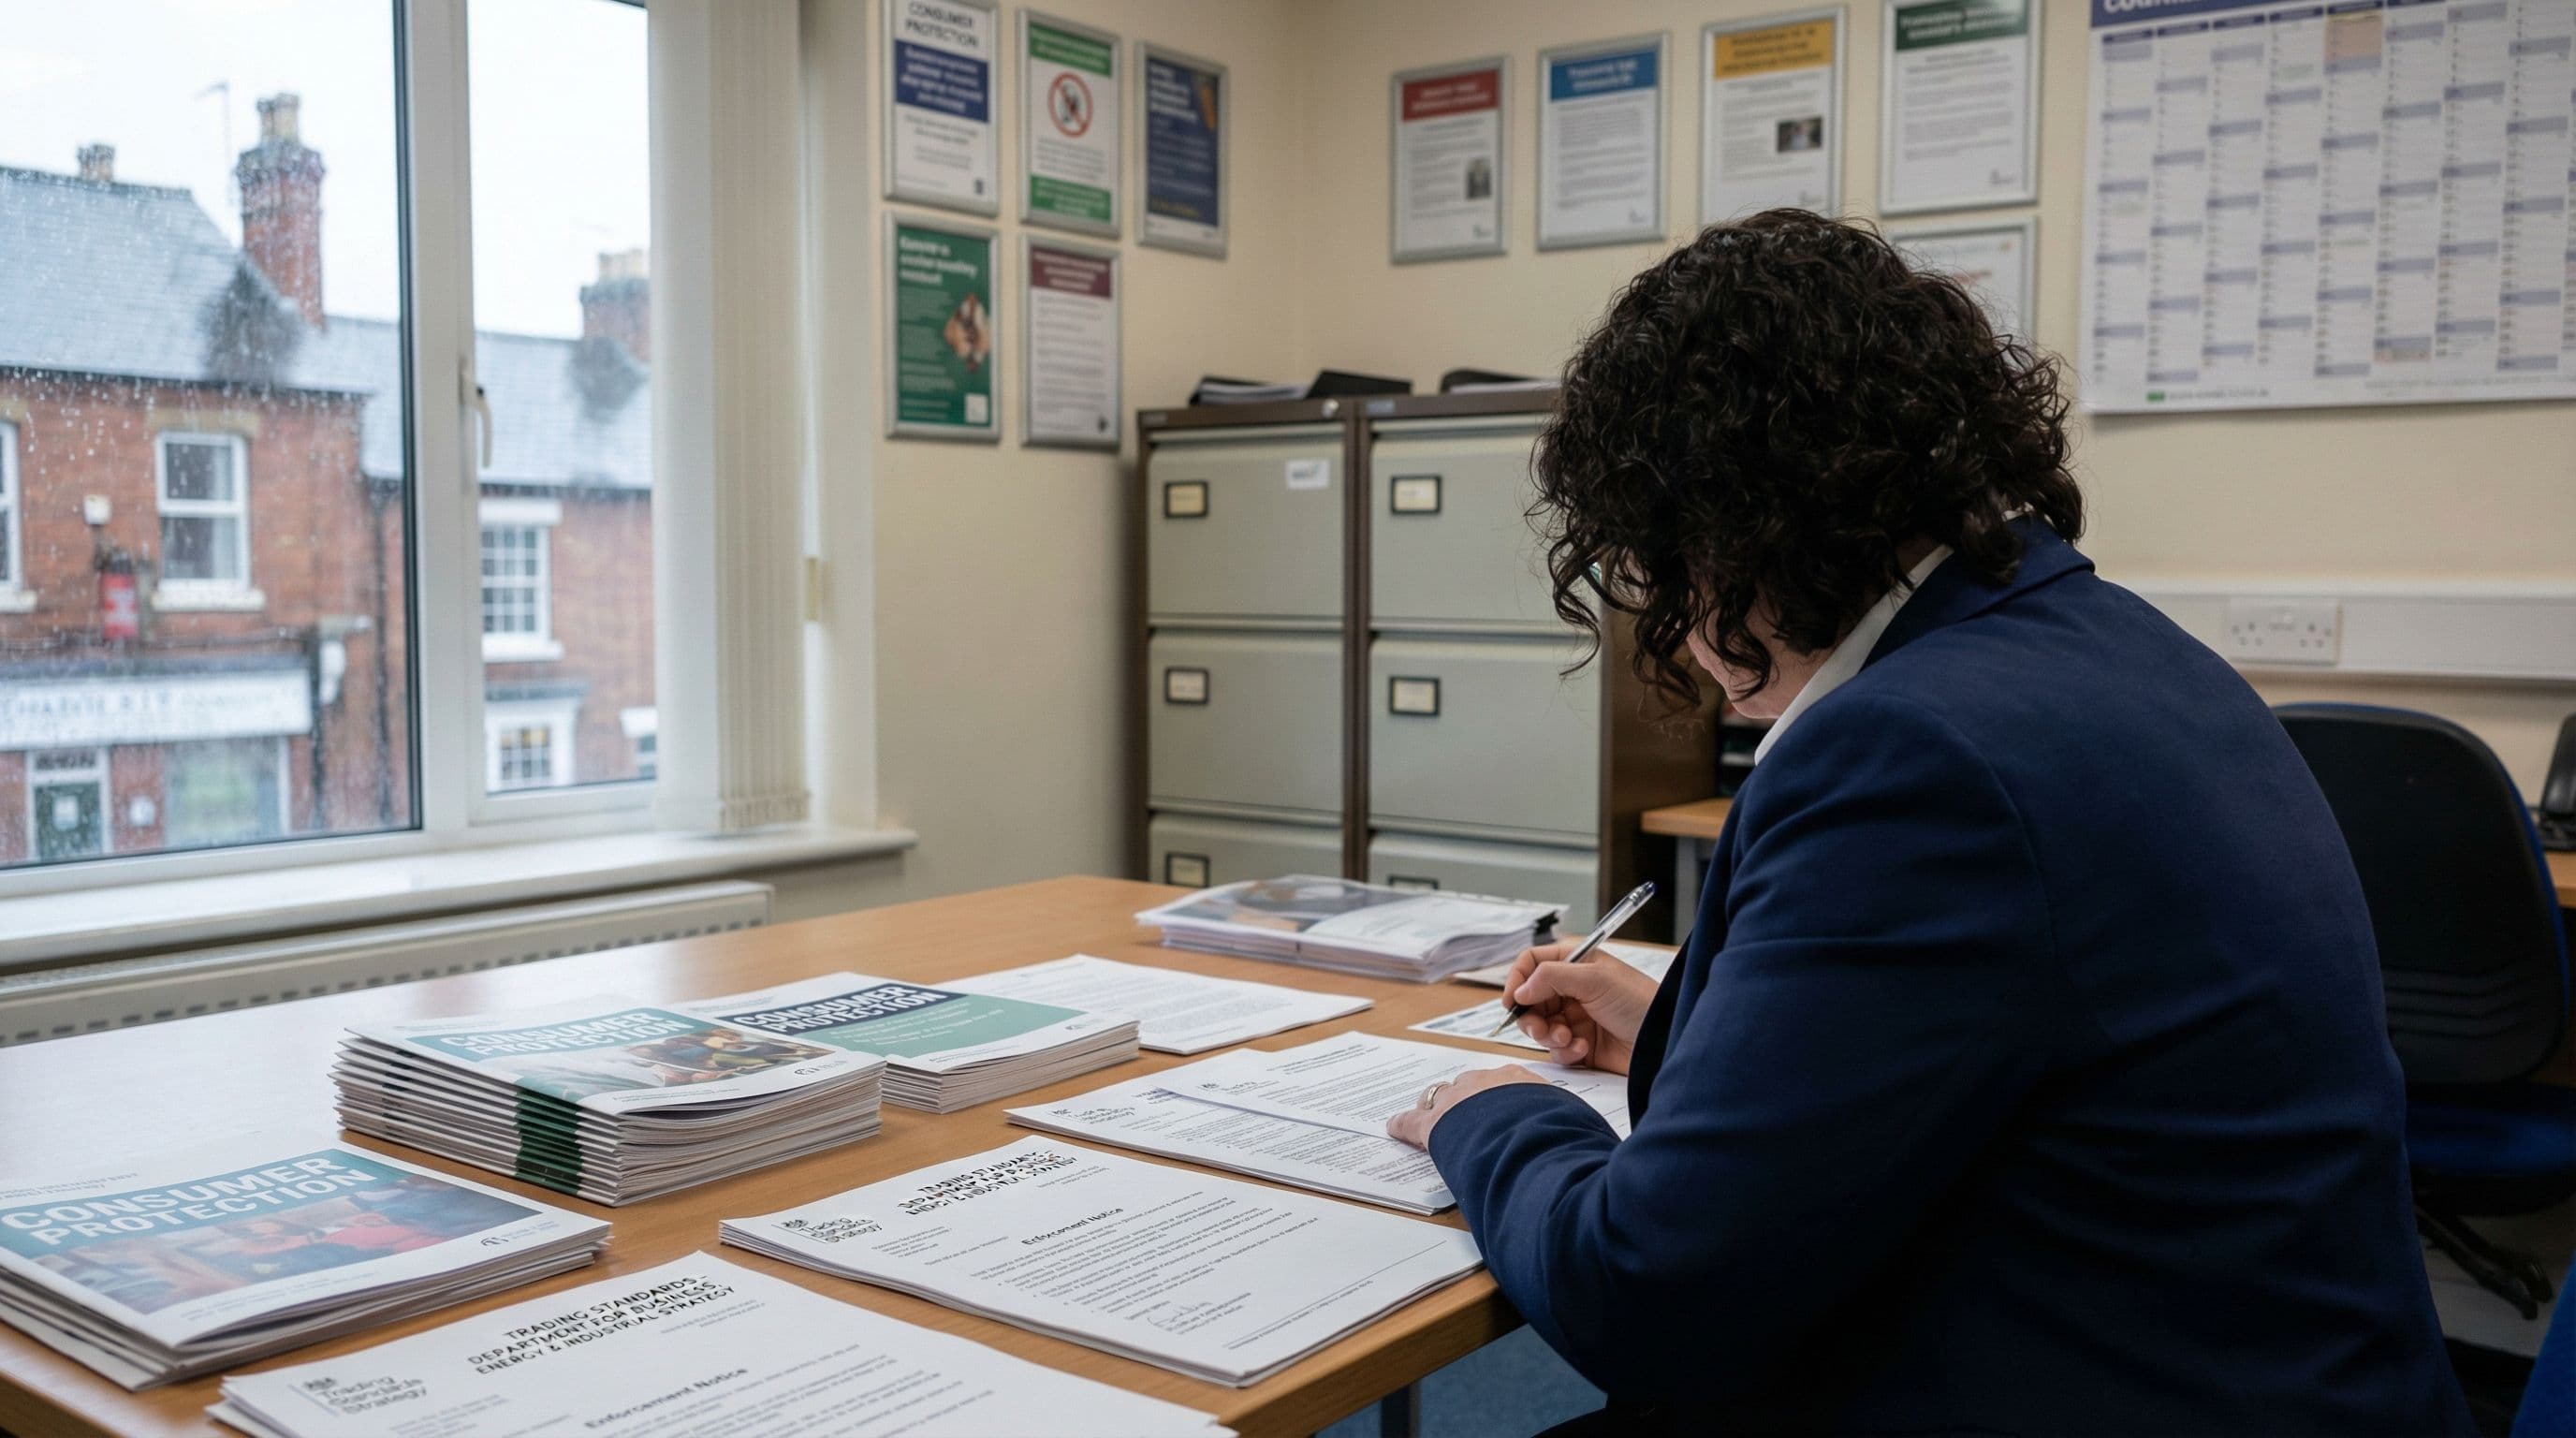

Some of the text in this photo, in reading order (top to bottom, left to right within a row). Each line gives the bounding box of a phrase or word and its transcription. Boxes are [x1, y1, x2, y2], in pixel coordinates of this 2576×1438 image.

[904, 18, 978, 47] PROTECTION
[908, 0, 973, 28] CONSUMER
[733, 984, 917, 1027] CONSUMER
[764, 991, 947, 1033] PROTECTION
[440, 1012, 665, 1047] CONSUMER
[470, 1020, 695, 1055] PROTECTION
[2, 1157, 348, 1230] CONSUMER
[30, 1168, 377, 1245] PROTECTION
[503, 1310, 588, 1340] TRADING
[591, 1277, 697, 1313] STANDARDS
[468, 1322, 585, 1364] DEPARTMENT
[476, 1348, 543, 1374] ENERGY
[564, 1315, 658, 1348] INDUSTRIAL
[658, 1286, 735, 1316] STRATEGY
